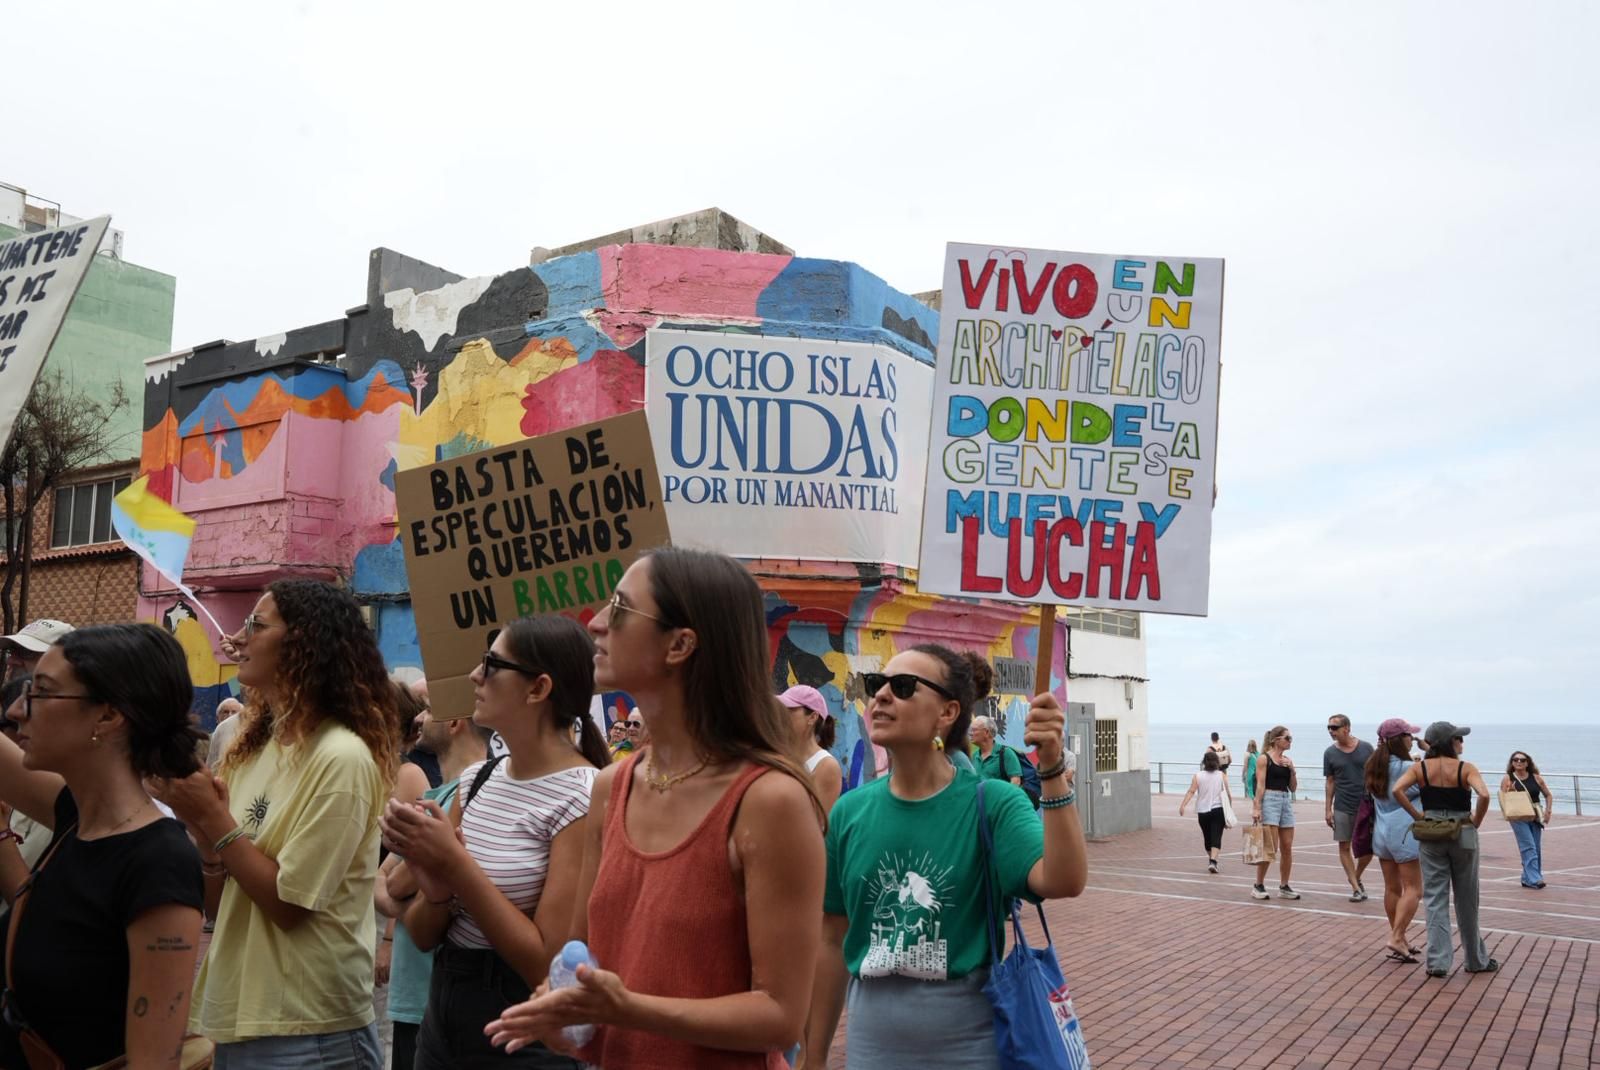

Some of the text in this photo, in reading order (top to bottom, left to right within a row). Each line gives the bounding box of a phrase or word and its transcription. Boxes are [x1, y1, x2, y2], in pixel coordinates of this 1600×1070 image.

[16, 270, 56, 304] MI
[1112, 259, 1196, 297] EN
[1107, 293, 1192, 329] UN
[665, 345, 897, 403] OCHO ISLAS
[665, 392, 898, 482] UNIDAS
[947, 395, 1200, 460] DONDE LA
[430, 448, 544, 511] BASTA
[664, 475, 898, 514] POR UN MANANTIAL
[943, 438, 1194, 499] GENTE SE
[411, 462, 654, 556] ESPECULACIÓN,
[946, 489, 1181, 545] MUEVE Y
[467, 514, 633, 582] QUEREMOS
[960, 516, 1161, 600] LUCHA
[450, 585, 497, 629] UN
